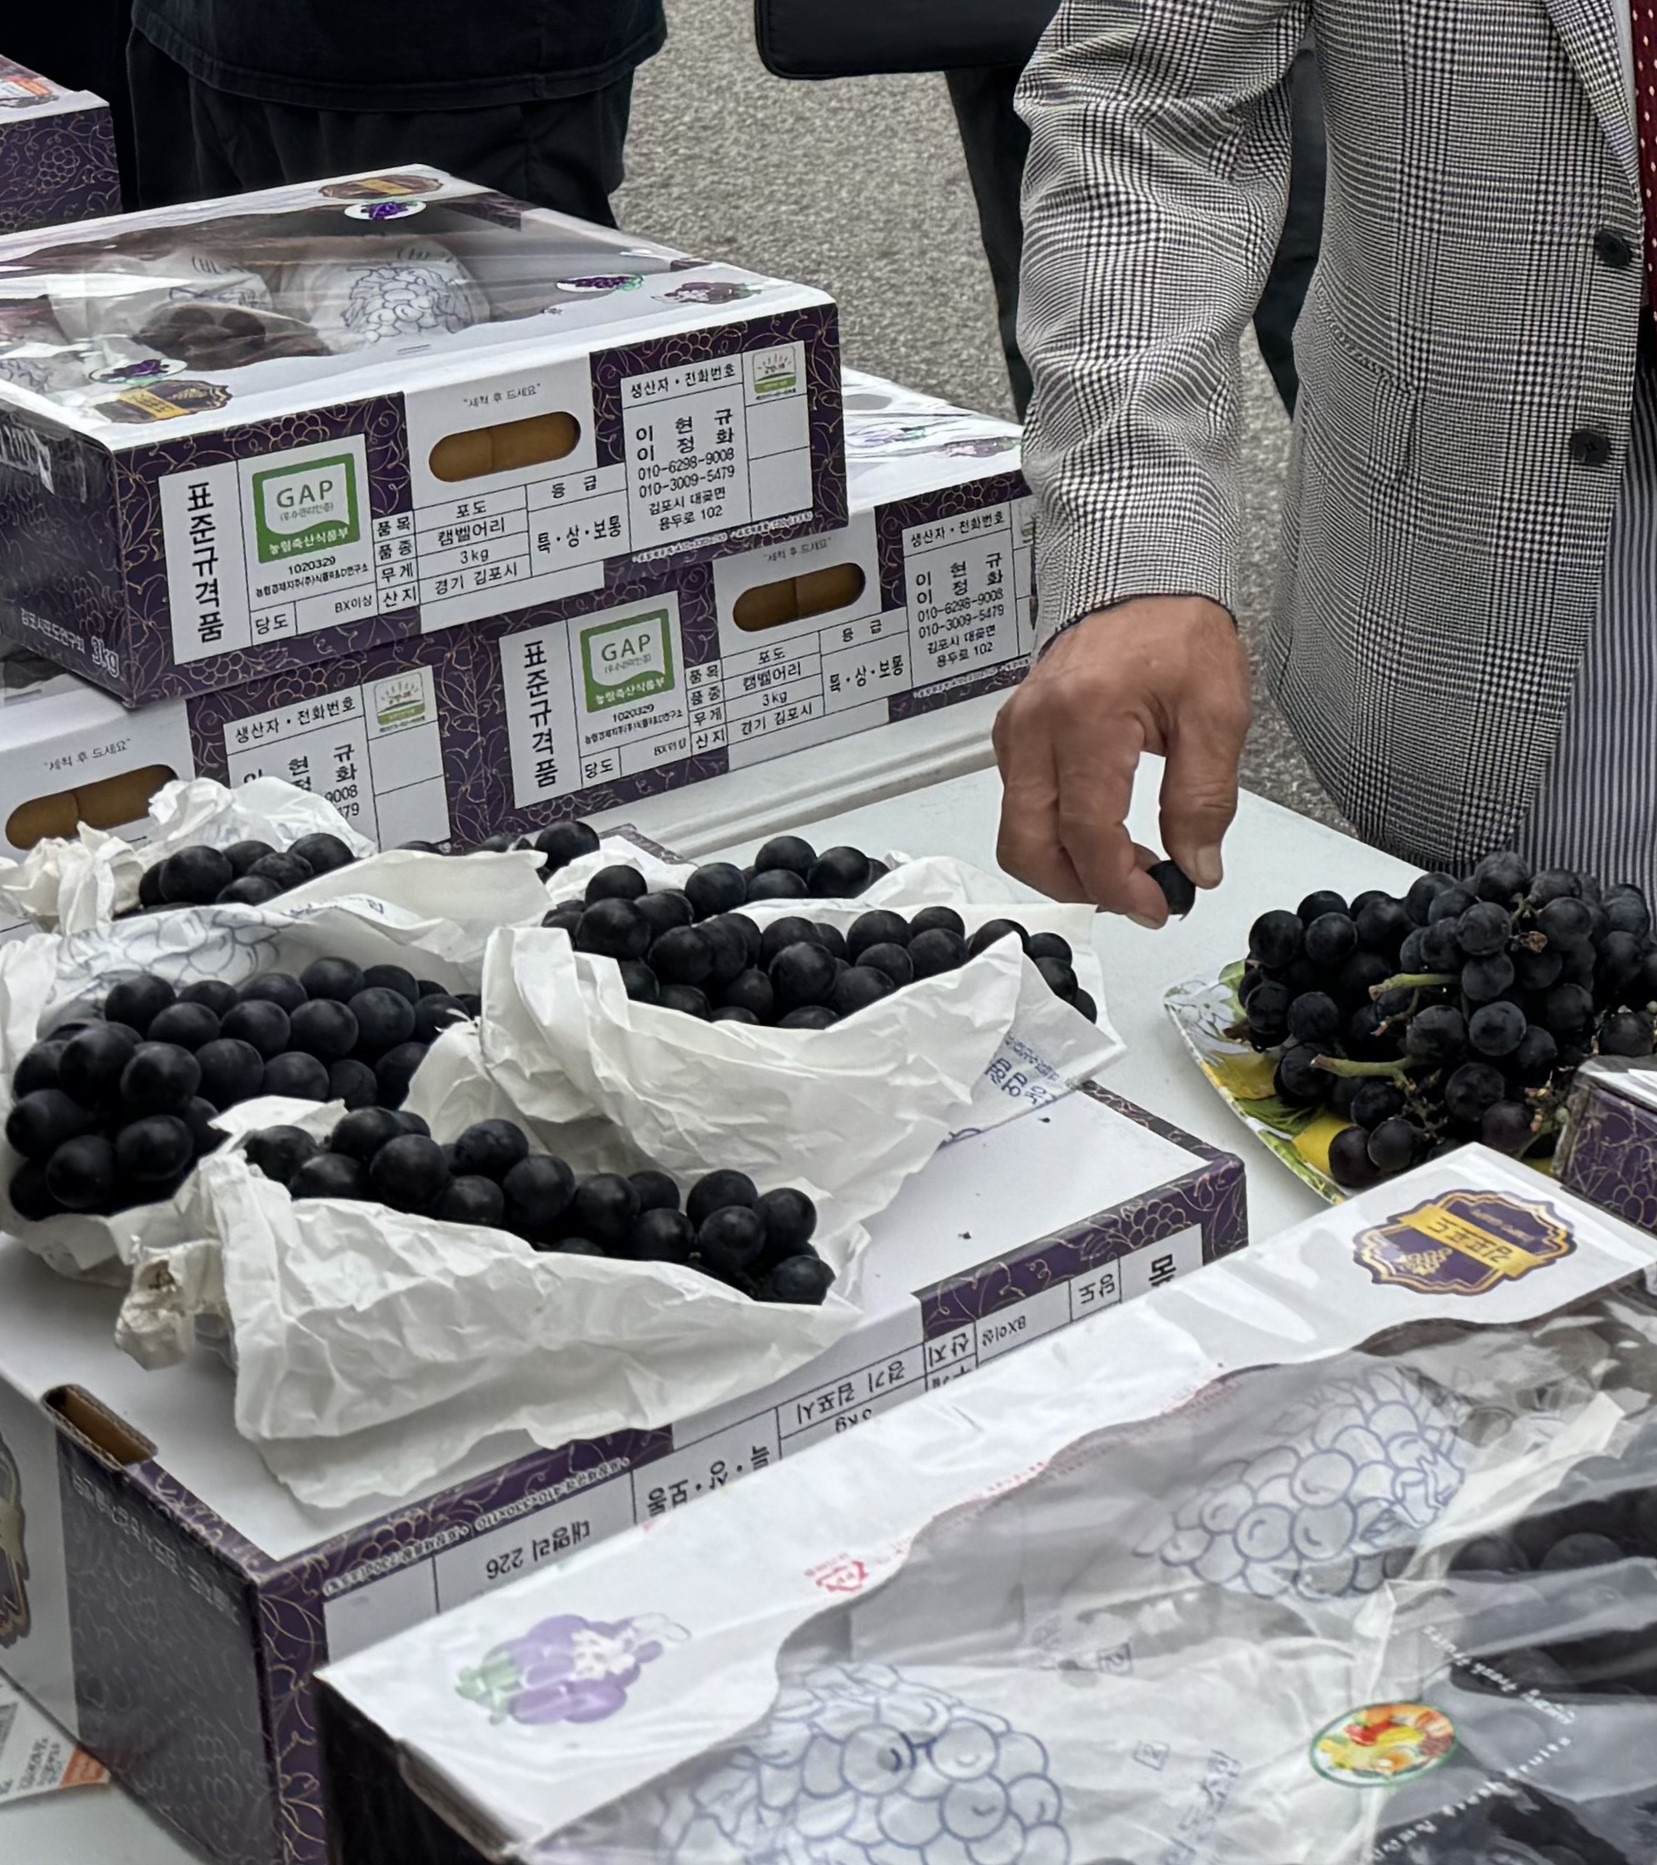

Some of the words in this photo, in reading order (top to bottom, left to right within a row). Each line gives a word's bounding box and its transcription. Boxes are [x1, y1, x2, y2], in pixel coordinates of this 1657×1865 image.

[630, 376, 669, 400] 생산자
[685, 362, 736, 388] 전화번호
[276, 480, 334, 509] GAP
[456, 499, 488, 520] 포도
[701, 504, 724, 520] 102
[376, 514, 412, 538] 품목
[437, 516, 506, 548] 캠벨어리
[910, 527, 947, 549] 생산자
[186, 481, 225, 644] 표준규격품
[378, 539, 413, 562] 품종
[459, 547, 490, 566] 3kg
[288, 555, 337, 576] 1020329
[381, 561, 415, 584] 무게
[434, 574, 466, 596] 경기
[474, 561, 519, 586] 김포시
[383, 585, 418, 608] 산지
[254, 612, 290, 636] 당도
[601, 634, 652, 663] GAP
[973, 641, 995, 657] 102
[761, 690, 789, 708] 3kg
[233, 718, 281, 745] 생산자
[295, 696, 357, 728] 전화번호
[523, 639, 560, 789] 표준규격품
[584, 757, 615, 780] 당도
[1078, 1272, 1116, 1305] 당도
[927, 1330, 971, 1368] 산지
[867, 1360, 906, 1393] 경기
[796, 1385, 856, 1425] 김포시
[532, 1518, 591, 1563] 대명리
[486, 1553, 525, 1581] 226
